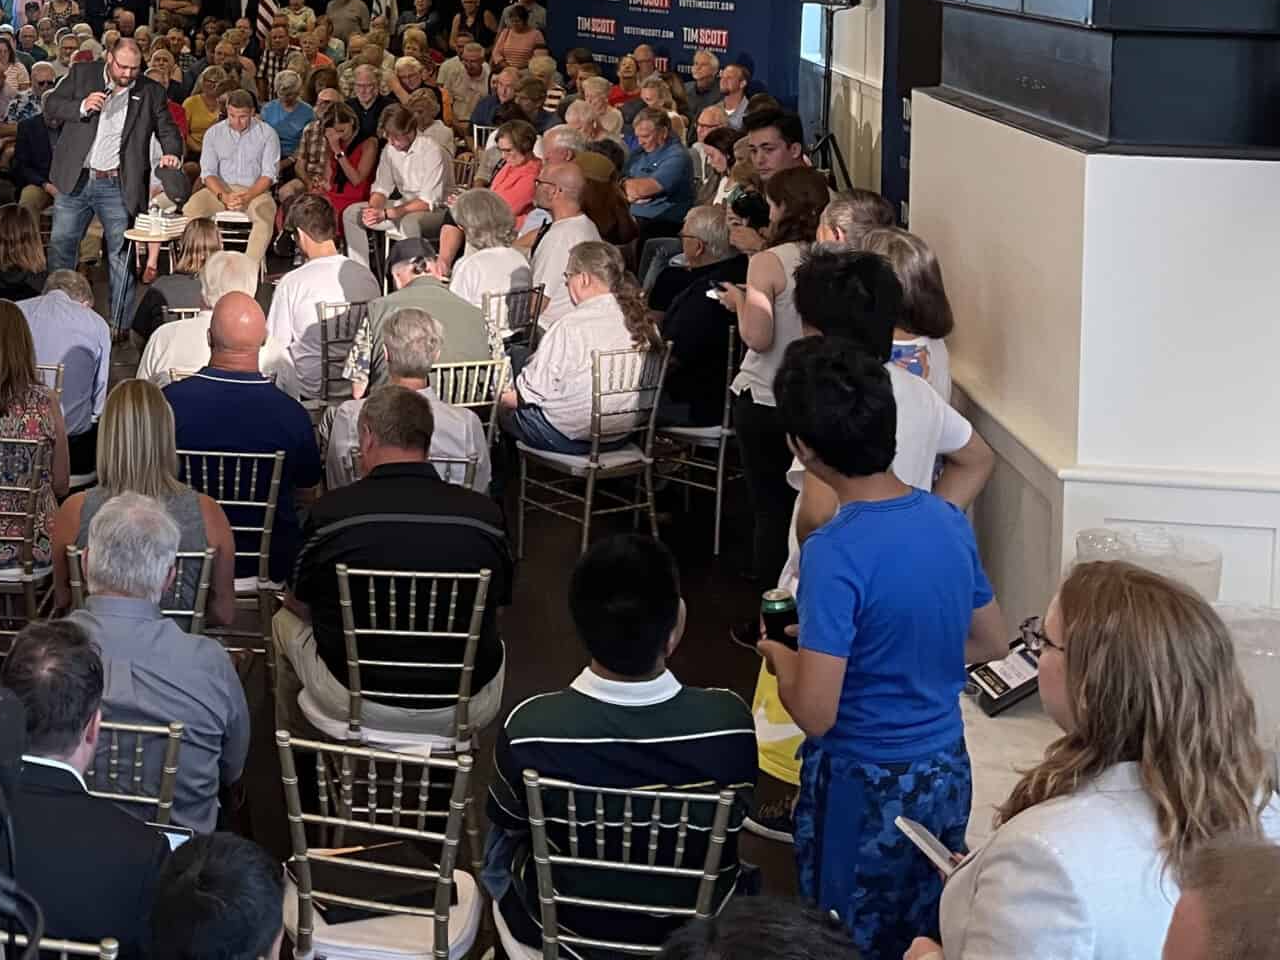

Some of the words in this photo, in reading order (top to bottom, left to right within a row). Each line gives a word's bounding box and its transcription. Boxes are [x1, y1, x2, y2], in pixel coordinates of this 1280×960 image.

[577, 16, 591, 31] TIM
[591, 18, 616, 34] SCOTT
[682, 27, 699, 43] TIM
[699, 29, 729, 48] SCOTT
